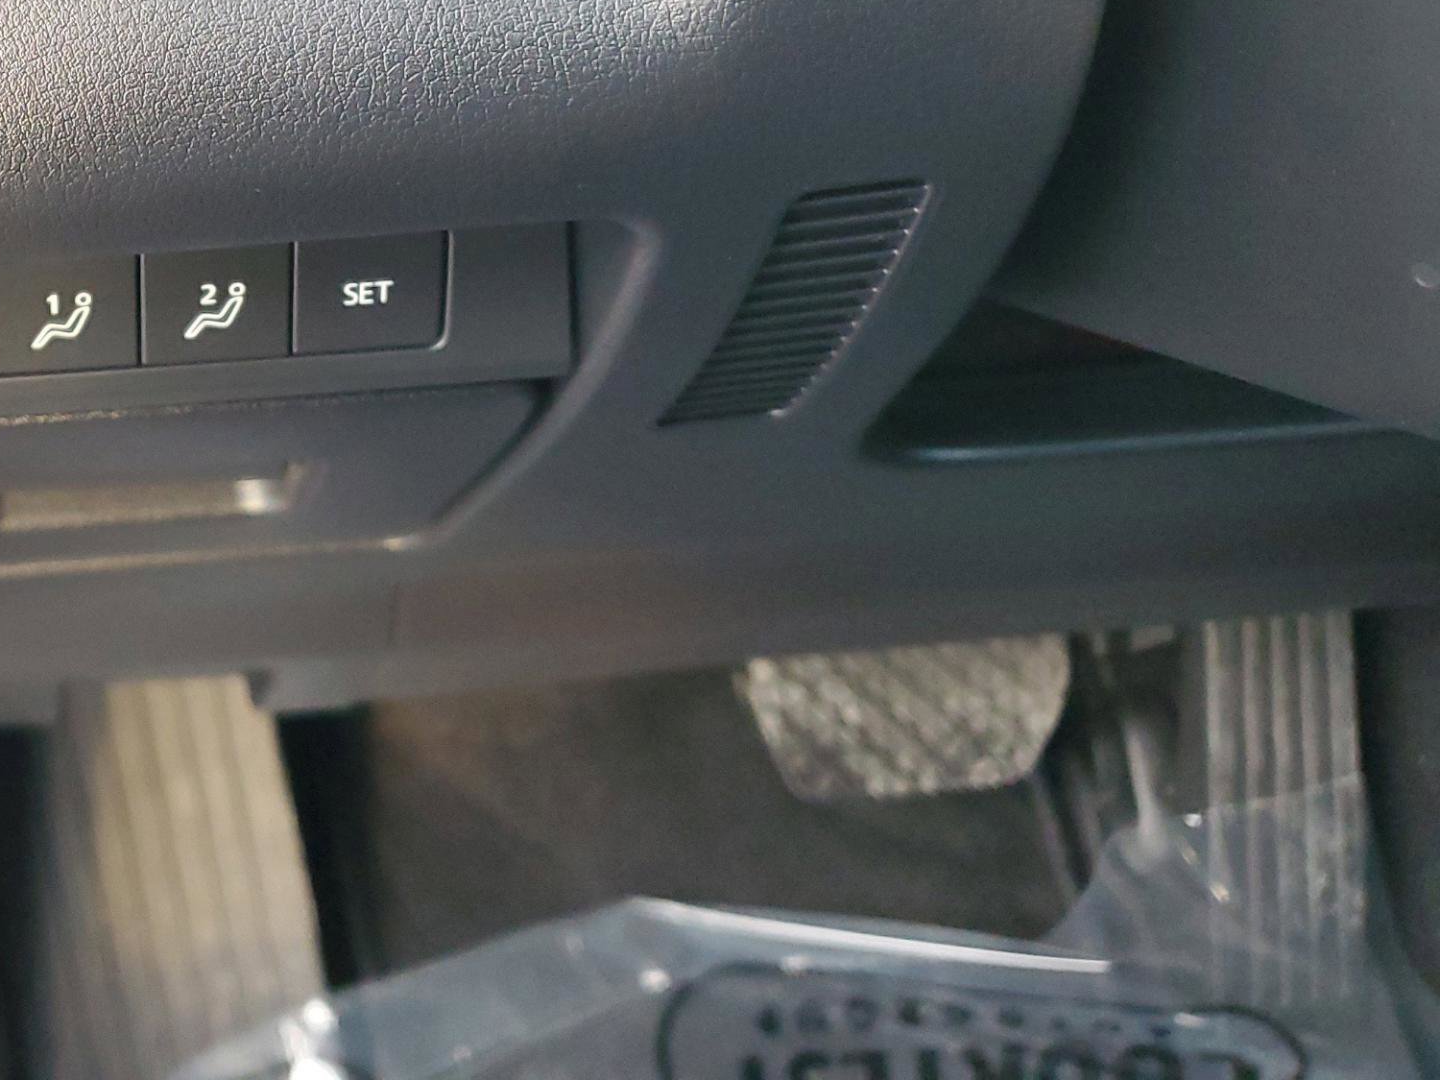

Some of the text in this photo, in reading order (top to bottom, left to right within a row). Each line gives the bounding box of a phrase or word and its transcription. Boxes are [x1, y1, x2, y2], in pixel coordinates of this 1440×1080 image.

[45, 293, 60, 316] 1
[199, 283, 218, 306] 2
[342, 279, 395, 307] SET
